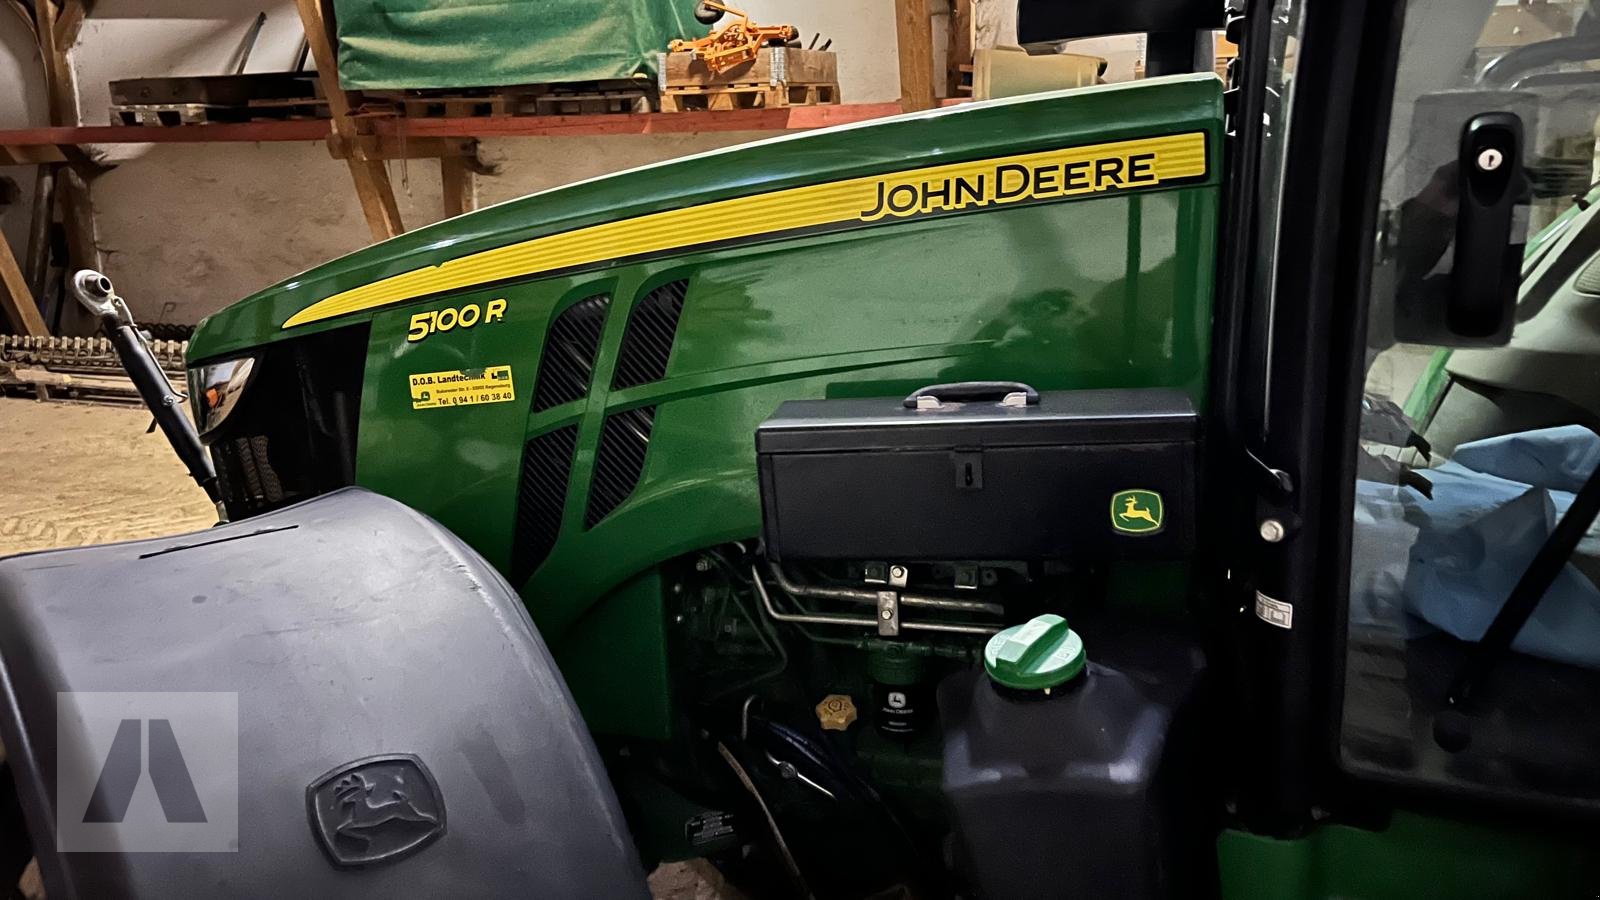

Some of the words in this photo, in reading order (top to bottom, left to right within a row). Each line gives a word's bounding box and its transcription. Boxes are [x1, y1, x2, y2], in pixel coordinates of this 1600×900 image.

[860, 174, 985, 217] JOHN
[995, 153, 1155, 200] DEERE
[407, 303, 481, 342] 5100
[484, 298, 507, 325] R
[412, 377, 436, 386] D.O.B.
[437, 372, 486, 384] Landteck
